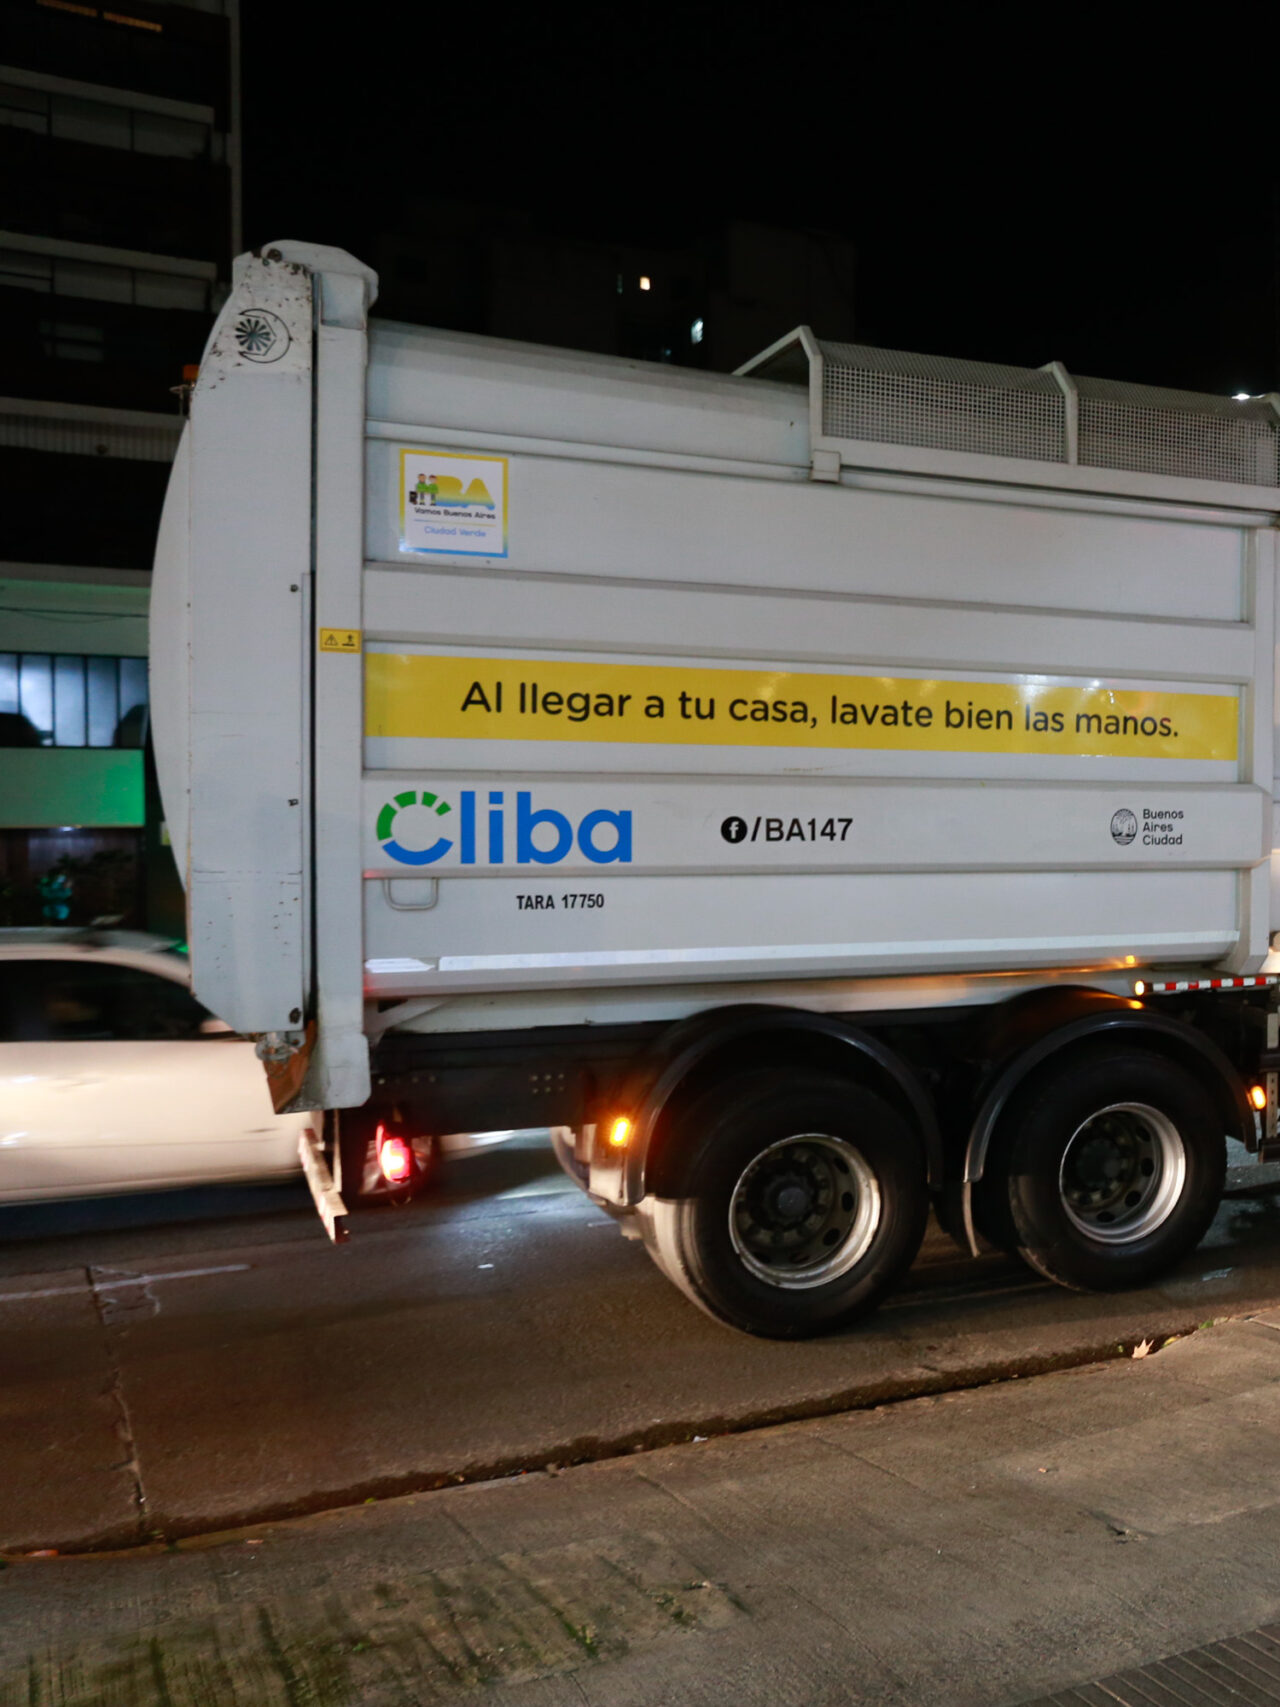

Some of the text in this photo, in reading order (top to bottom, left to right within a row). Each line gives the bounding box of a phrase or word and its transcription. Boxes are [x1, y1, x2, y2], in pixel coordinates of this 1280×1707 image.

[414, 507, 496, 520] Vamos Buenos Aires
[424, 526, 486, 537] Ciudad Verde
[461, 681, 1179, 738] Al llegar a tu casa, lavate bien las manos.
[1143, 808, 1184, 820] Buenos
[376, 791, 632, 866] Cliba
[1143, 822, 1174, 833] Aires
[1143, 833, 1183, 846] Ciudad
[516, 894, 604, 910] TARA 17750
